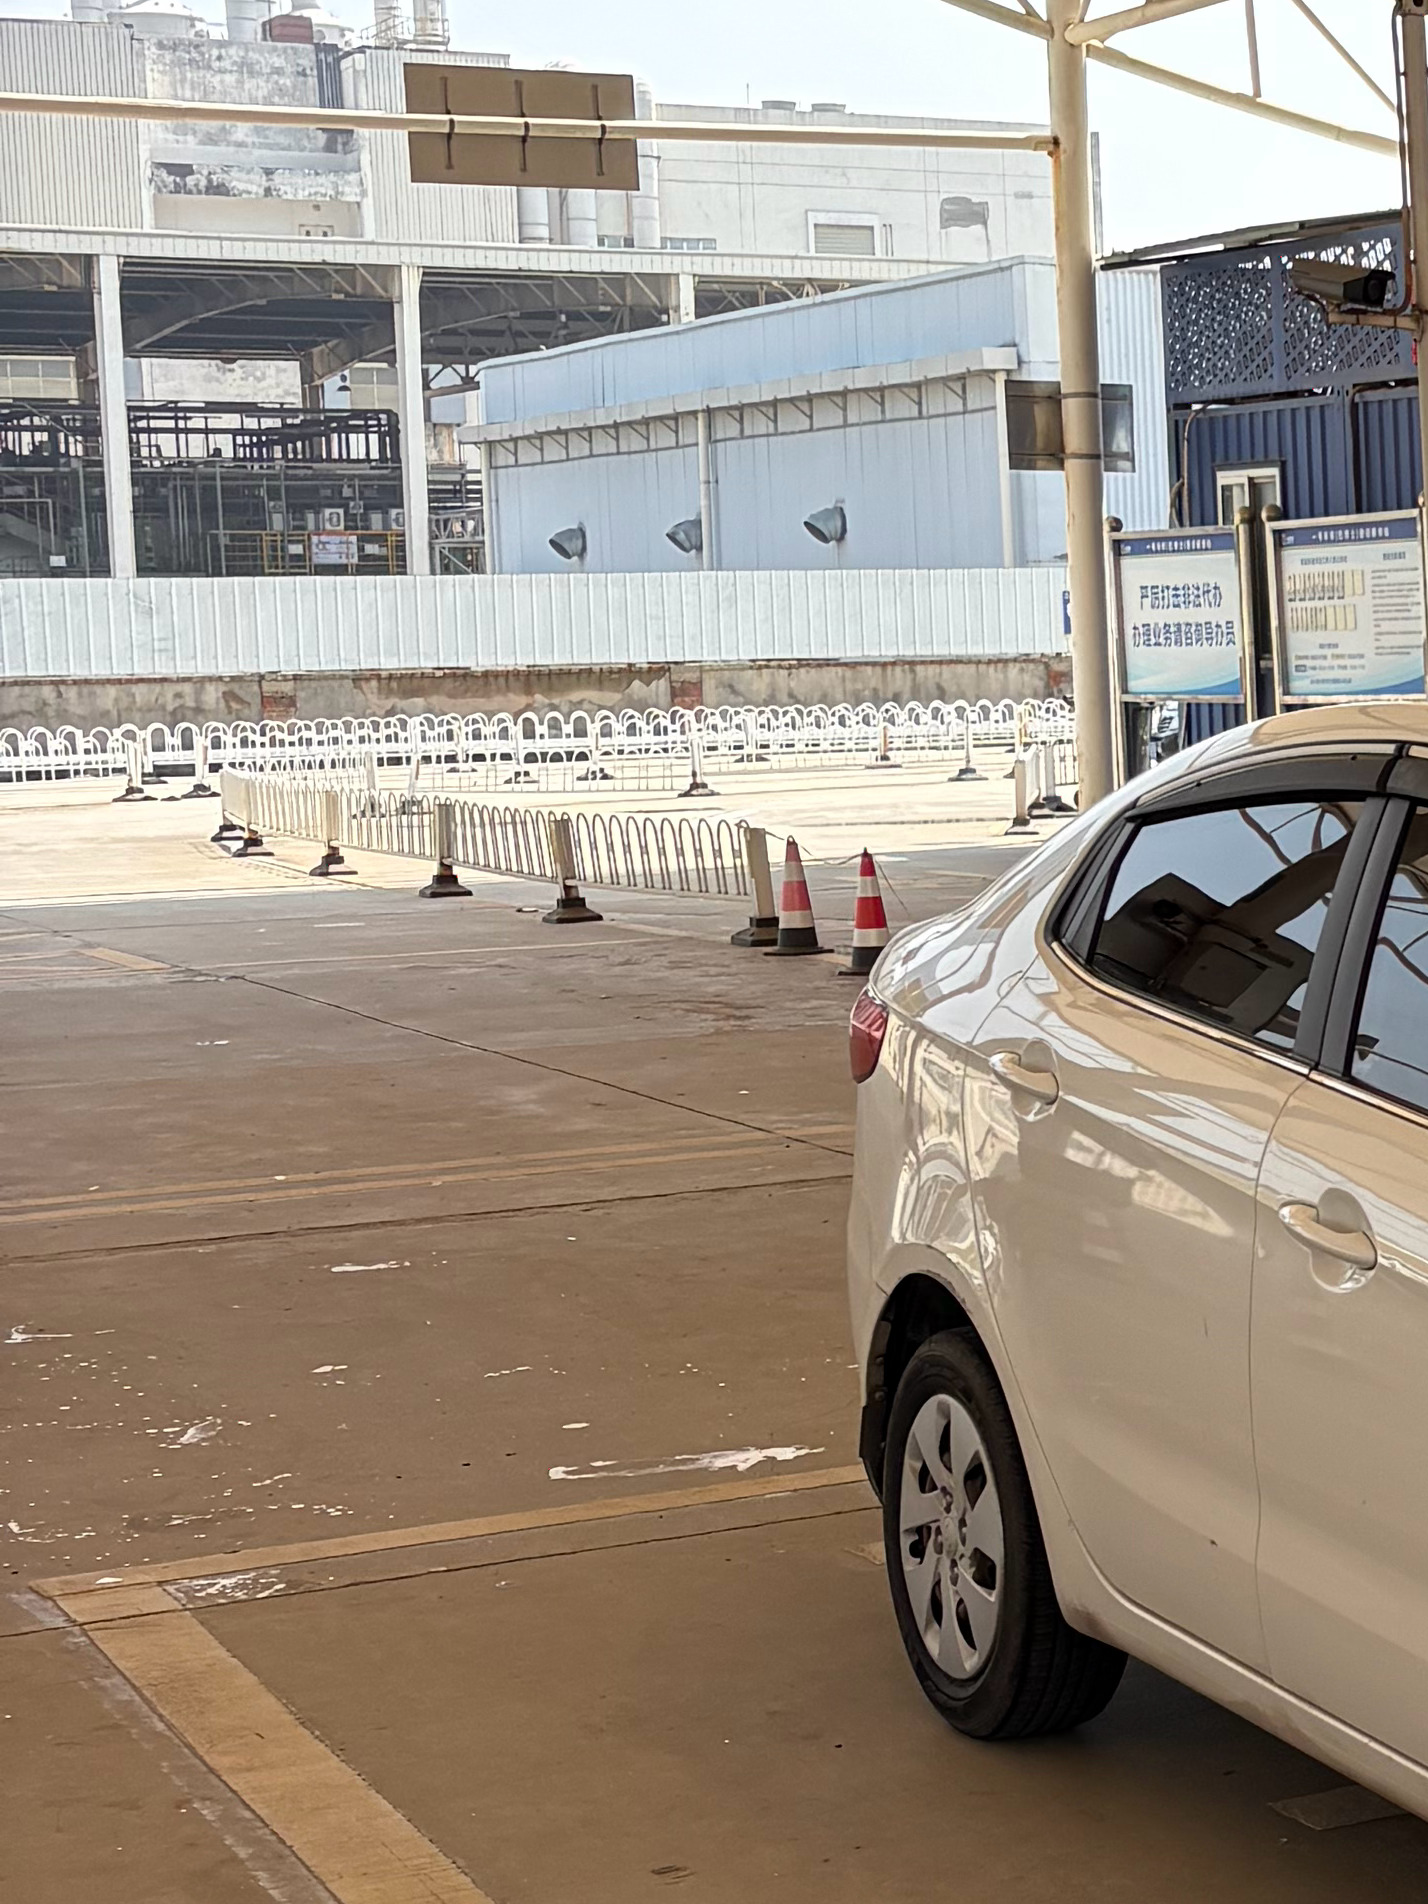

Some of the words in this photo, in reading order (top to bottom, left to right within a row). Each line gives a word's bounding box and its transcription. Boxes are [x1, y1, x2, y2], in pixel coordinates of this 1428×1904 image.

[1139, 581, 1223, 611] 严厉打击非法代办
